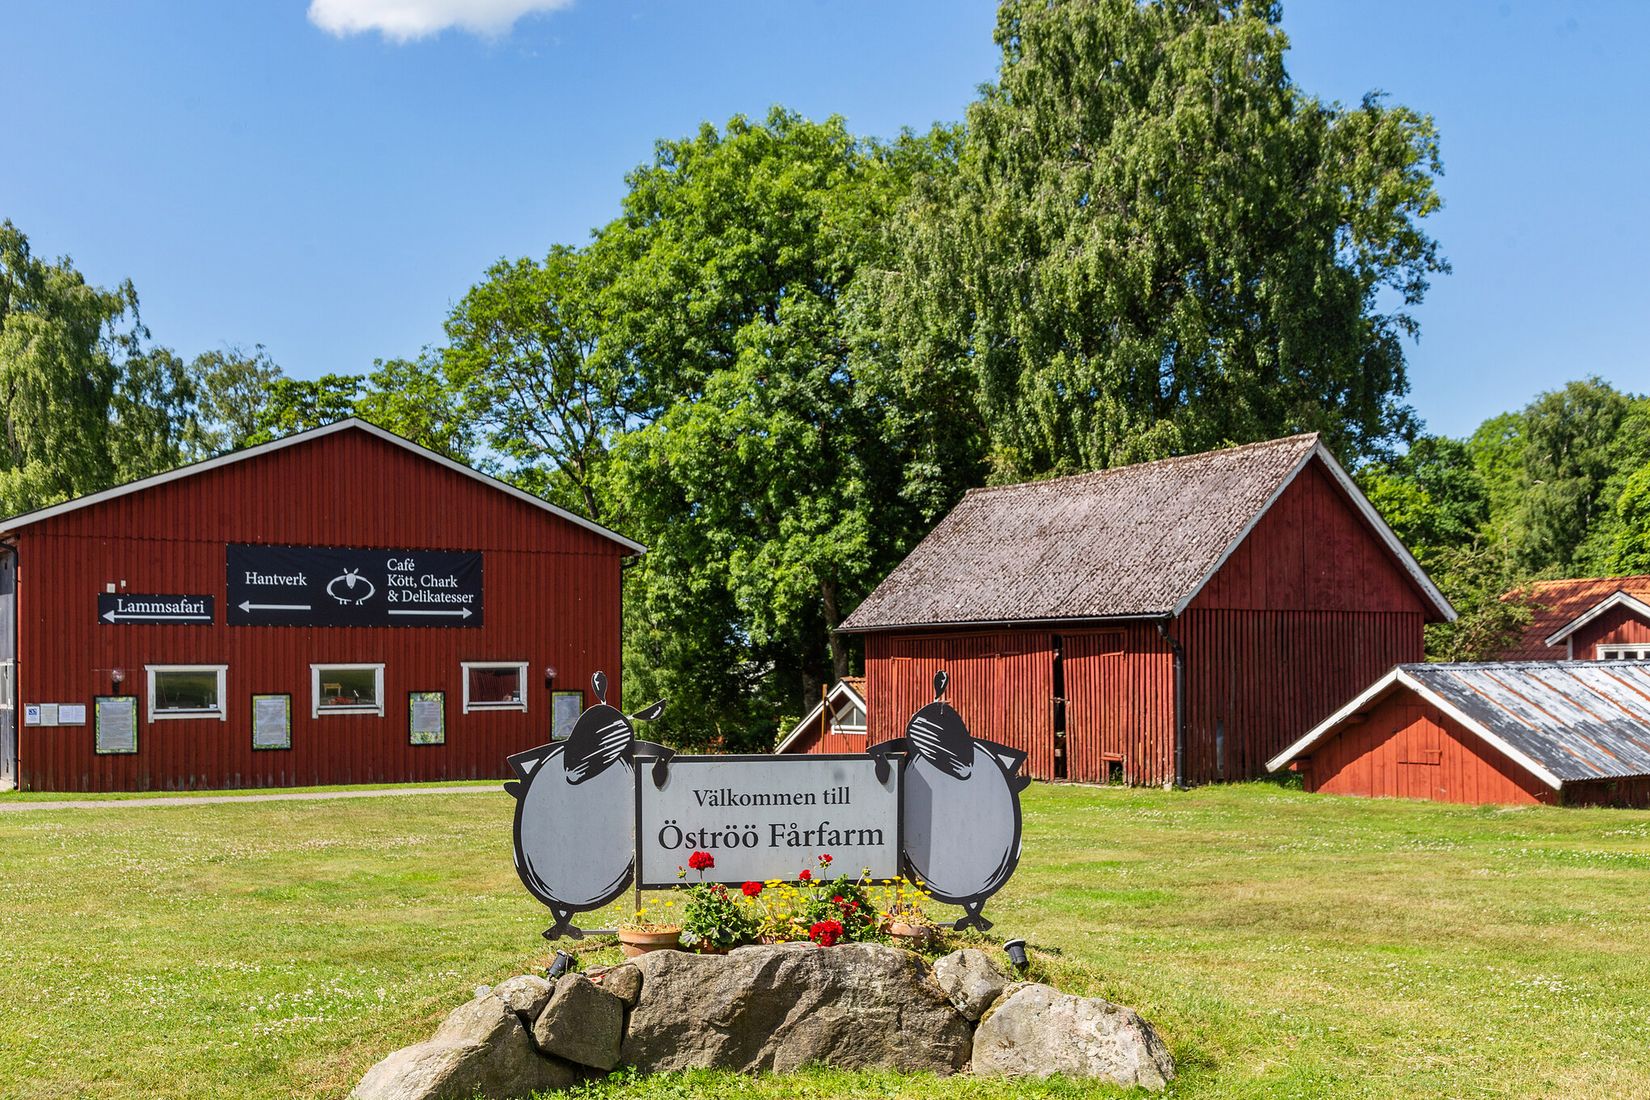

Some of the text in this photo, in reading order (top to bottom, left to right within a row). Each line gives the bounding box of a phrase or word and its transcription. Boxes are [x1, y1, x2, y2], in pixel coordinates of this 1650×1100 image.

[386, 558, 415, 571] Café
[245, 572, 308, 586] Hantverk
[387, 574, 458, 588] Kött, Chark
[387, 590, 474, 604] & Delikatesser
[117, 599, 205, 614] Lammsafari
[692, 787, 851, 807] Välkommen till
[658, 820, 885, 849] Öströö Fårfarm
